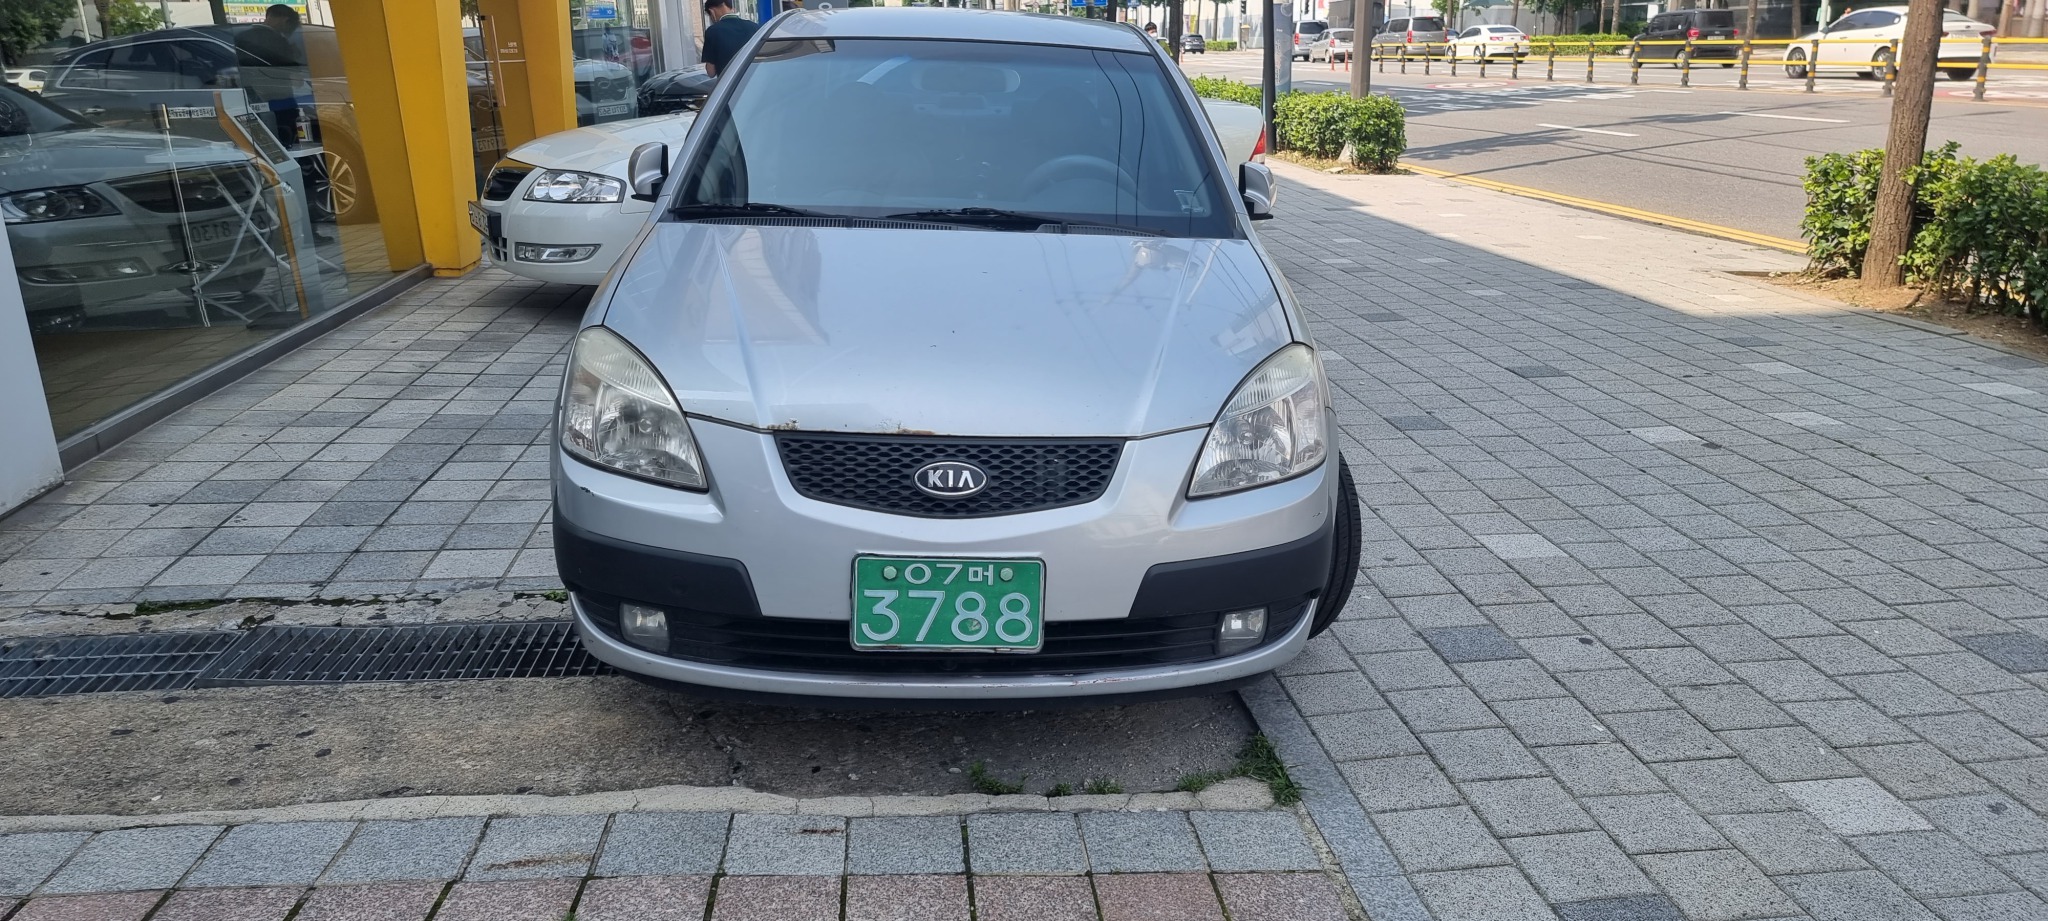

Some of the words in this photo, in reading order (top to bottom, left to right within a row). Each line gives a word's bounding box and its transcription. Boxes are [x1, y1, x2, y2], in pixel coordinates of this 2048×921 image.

[927, 470, 975, 488] KIA
[904, 563, 994, 585] 07머
[861, 590, 1033, 643] 3788
